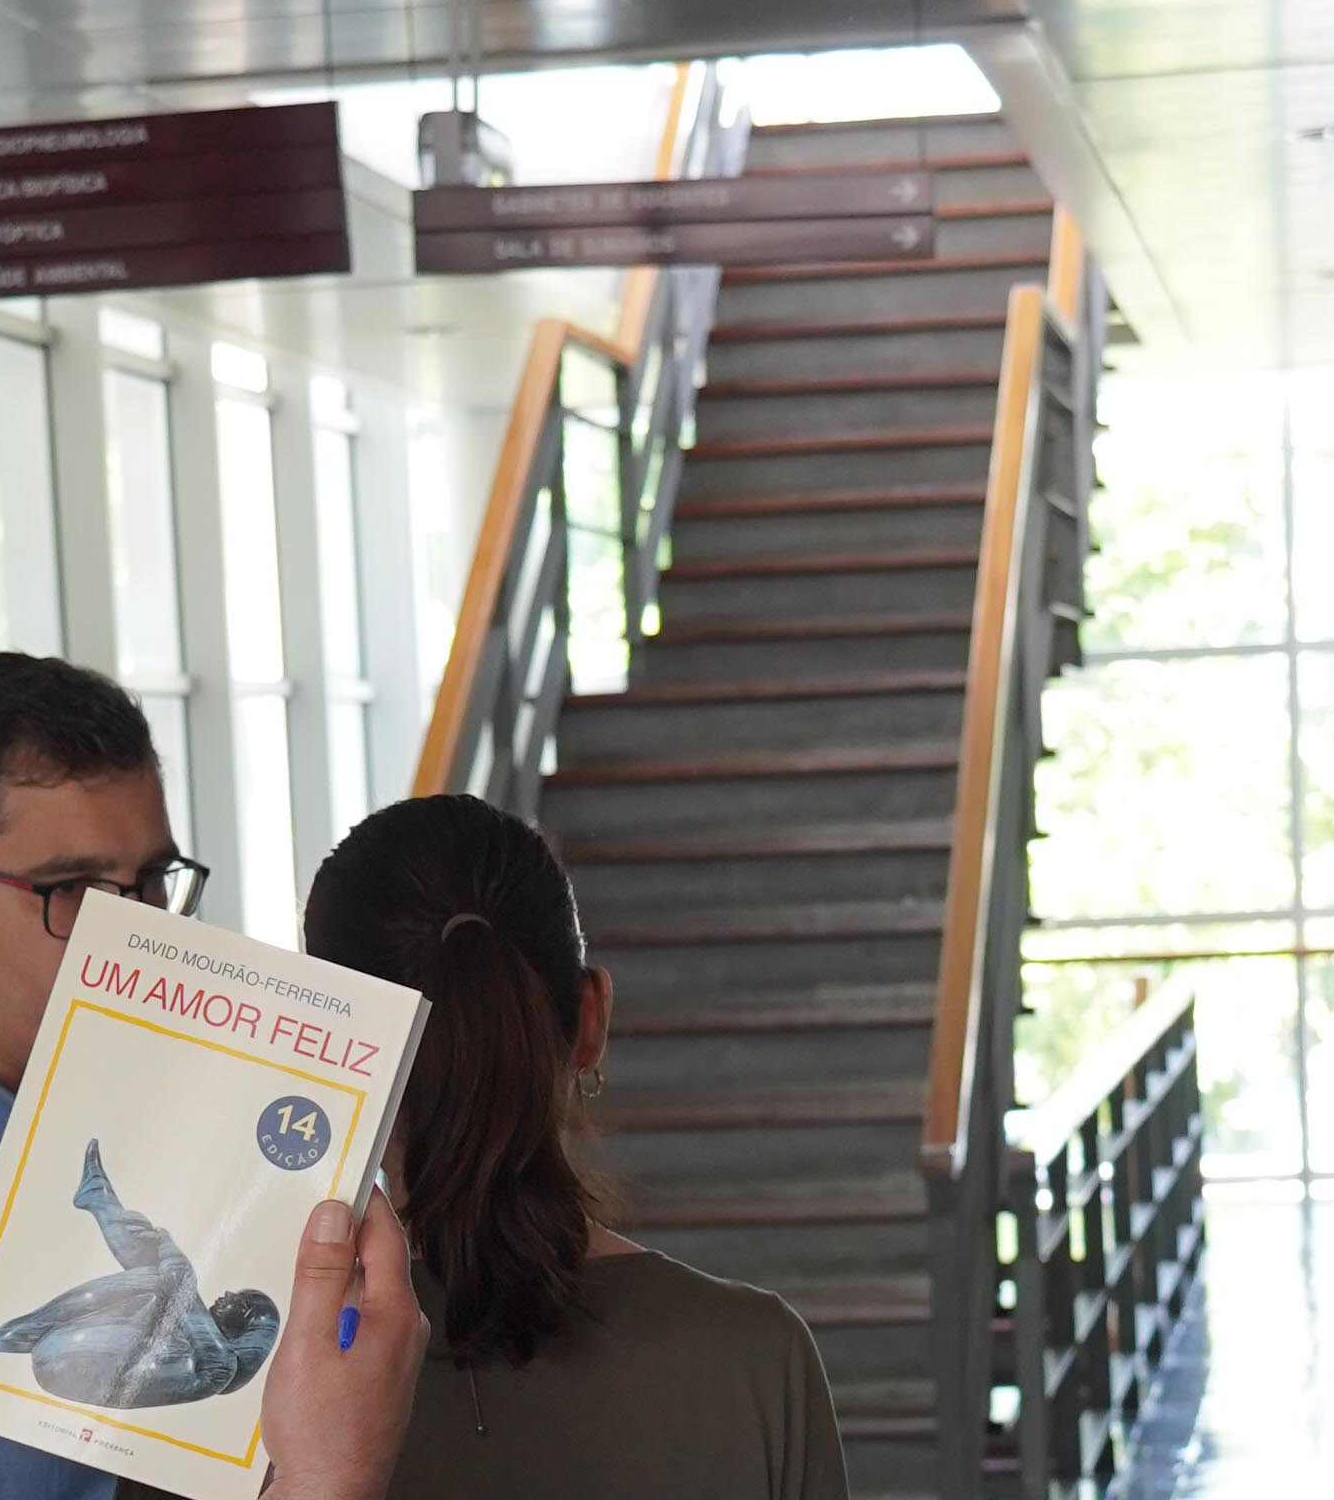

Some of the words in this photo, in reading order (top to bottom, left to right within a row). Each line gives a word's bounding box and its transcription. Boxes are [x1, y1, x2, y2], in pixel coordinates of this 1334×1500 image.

[80, 954, 141, 1000] UM
[142, 974, 263, 1040] AMOR
[269, 1013, 382, 1078] FELIZ
[127, 932, 179, 963] DAVID
[181, 950, 353, 1018] MOURÃO-FERREIRA
[261, 1134, 318, 1167] EDIÇÃO
